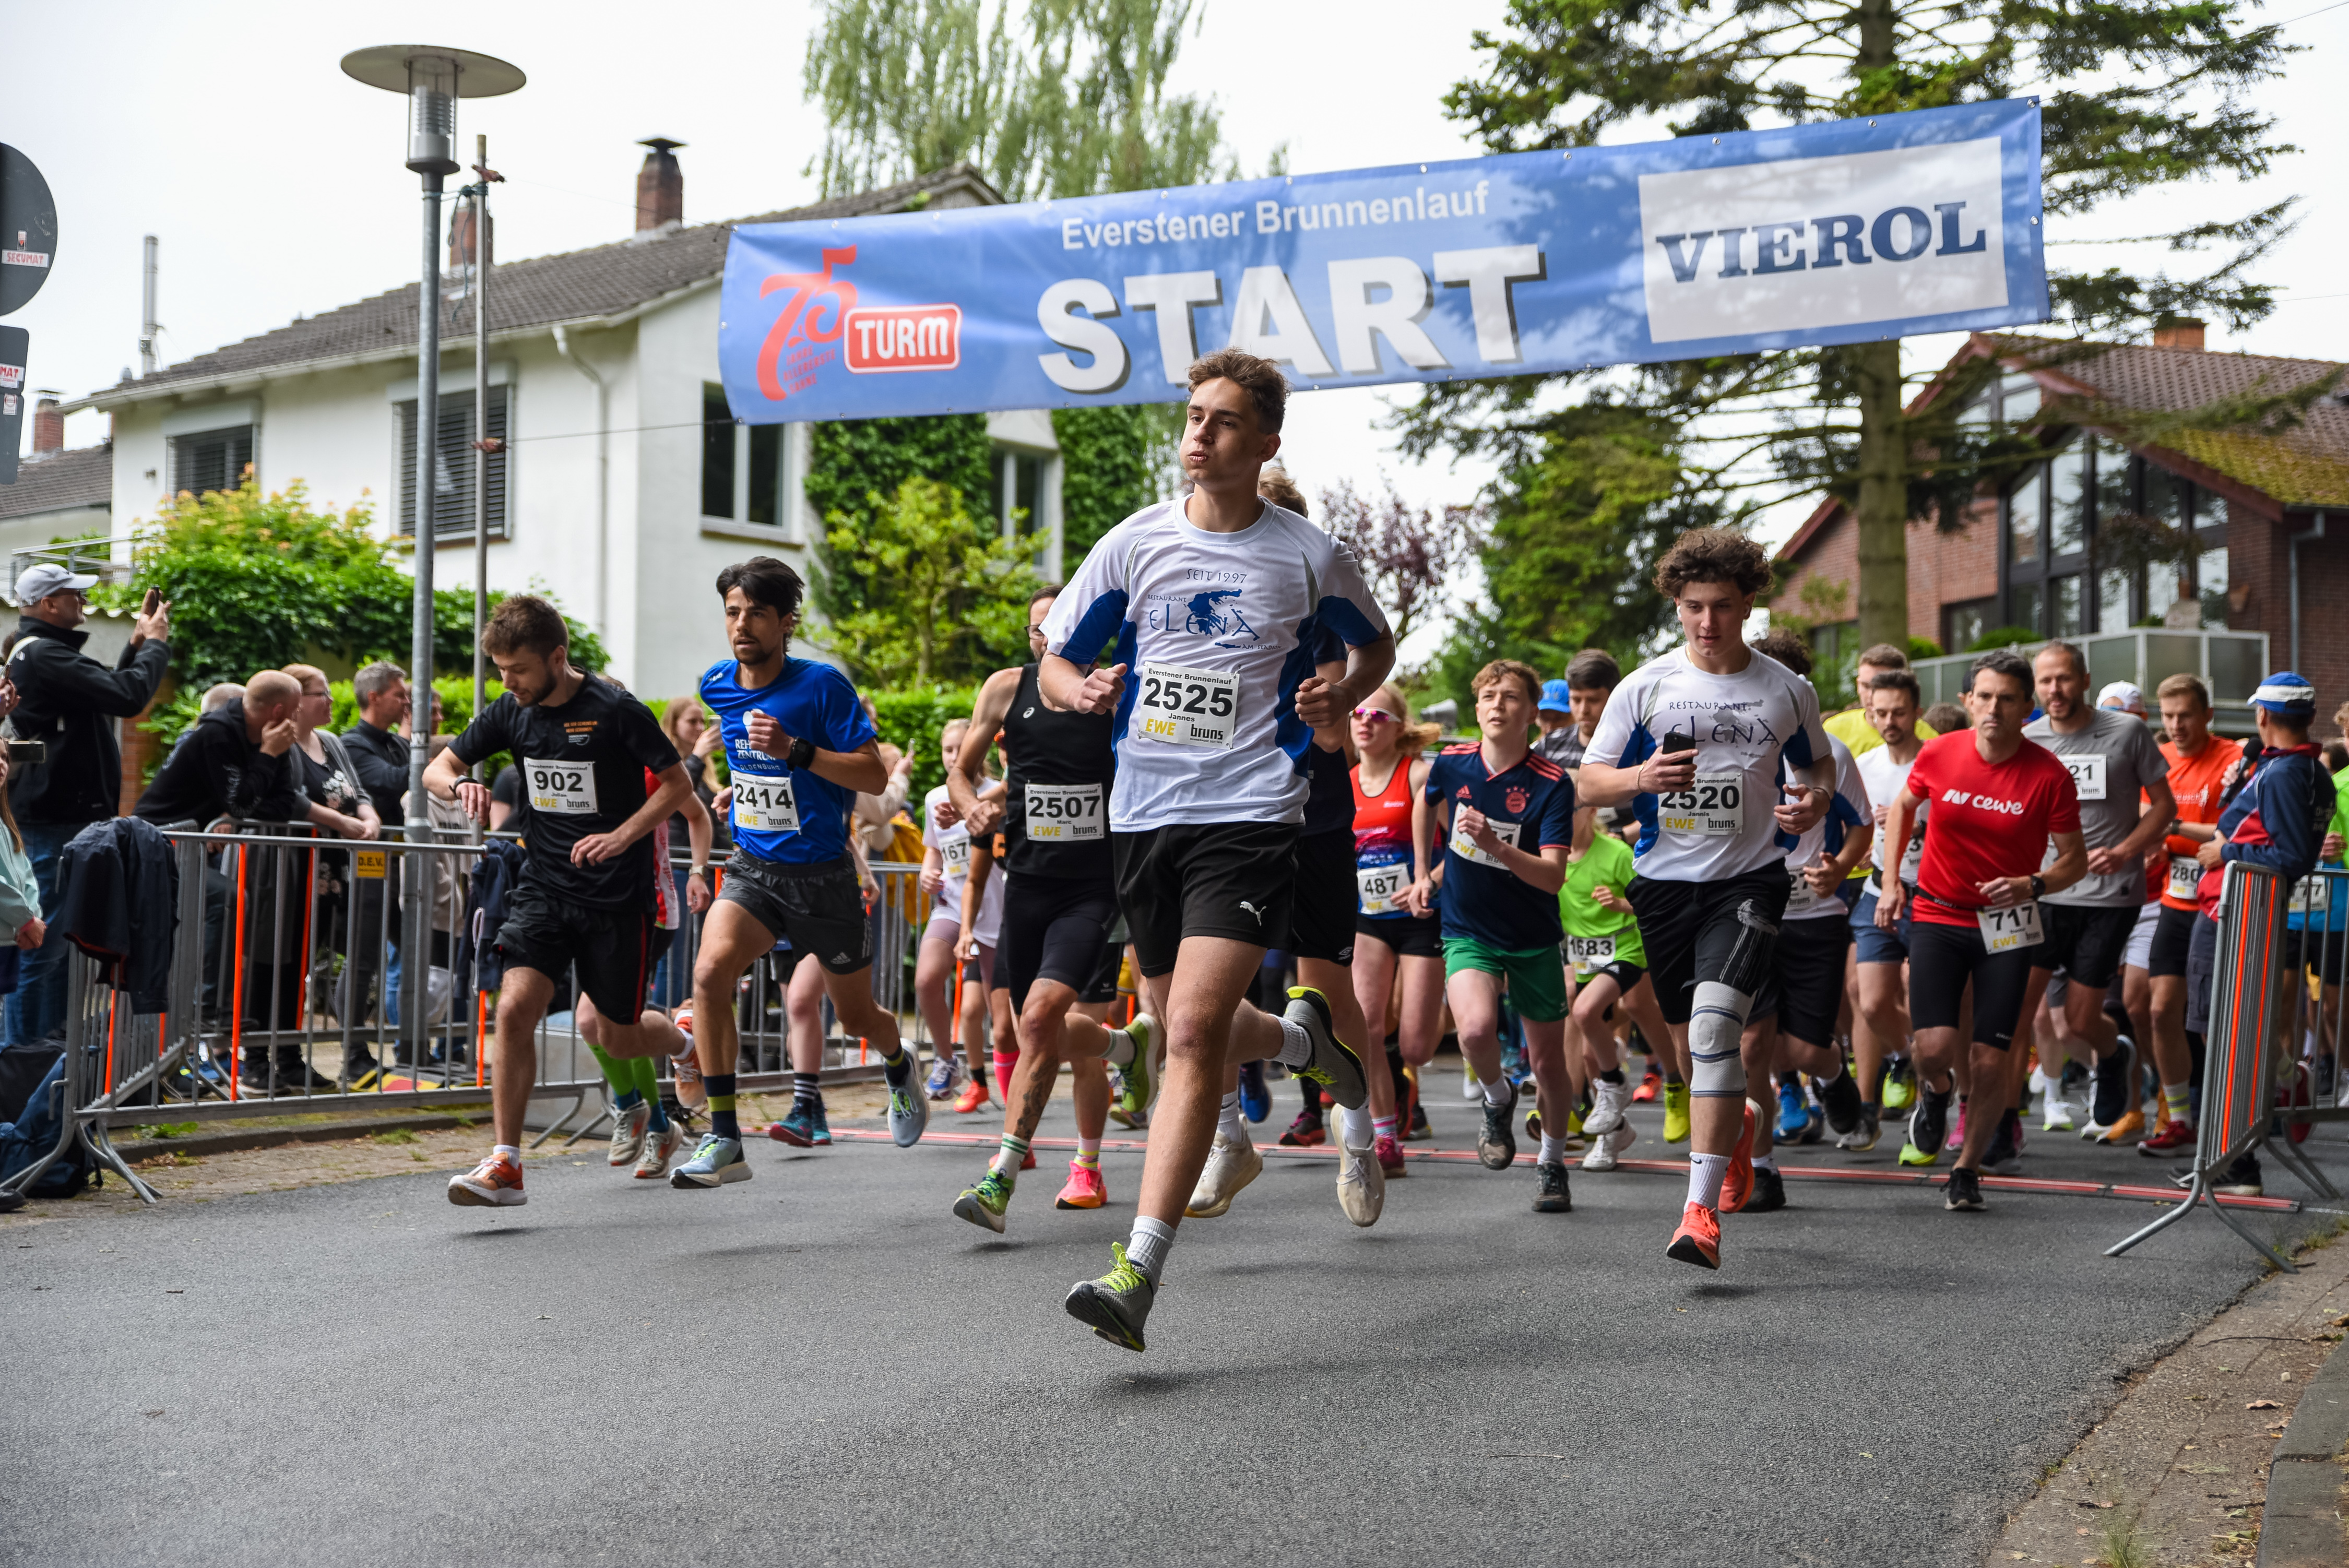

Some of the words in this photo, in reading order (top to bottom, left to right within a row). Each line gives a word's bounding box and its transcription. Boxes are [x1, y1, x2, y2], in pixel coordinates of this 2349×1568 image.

[1061, 210, 1244, 251] Everstener
[1255, 181, 1489, 235] Brunnenlauf
[1656, 201, 1987, 283] VIEROL
[7, 252, 43, 264] SECUMAT
[1037, 243, 1546, 395] START
[855, 316, 949, 360] TURM
[1186, 568, 1213, 581] SEIT
[1218, 572, 1248, 584] 1997
[1147, 594, 1187, 603] RESTAURANT
[1149, 603, 1261, 641] ELENA
[1148, 668, 1182, 679] Everstener
[1184, 674, 1232, 685] Brunnenlauf
[1143, 678, 1233, 717] 2525
[1669, 702, 1749, 711] RESTAURANT
[1168, 713, 1195, 722] Jannes
[1145, 718, 1177, 736] EWE
[1190, 724, 1224, 740] bruns
[735, 739, 752, 750] REH
[2067, 765, 2092, 780] 21
[534, 771, 583, 792] 902
[535, 797, 557, 808] EWE
[566, 799, 589, 807] bruns
[734, 783, 793, 809] 2414
[1661, 786, 1740, 810] 2520
[1972, 794, 2024, 815] cewe
[1028, 795, 1100, 818] 2507
[739, 813, 758, 825] EWE
[768, 816, 792, 825] bruns
[1666, 817, 1695, 829] EWE
[1708, 818, 1735, 828] bruns
[1034, 826, 1061, 837] EWE
[1073, 825, 1097, 835] bruns
[942, 841, 971, 861] 167
[1456, 840, 1476, 857] EWE
[1365, 875, 1398, 896] 487
[1989, 906, 2033, 932] 717
[1570, 939, 1612, 956] 1683
[1993, 935, 2017, 948] EWE
